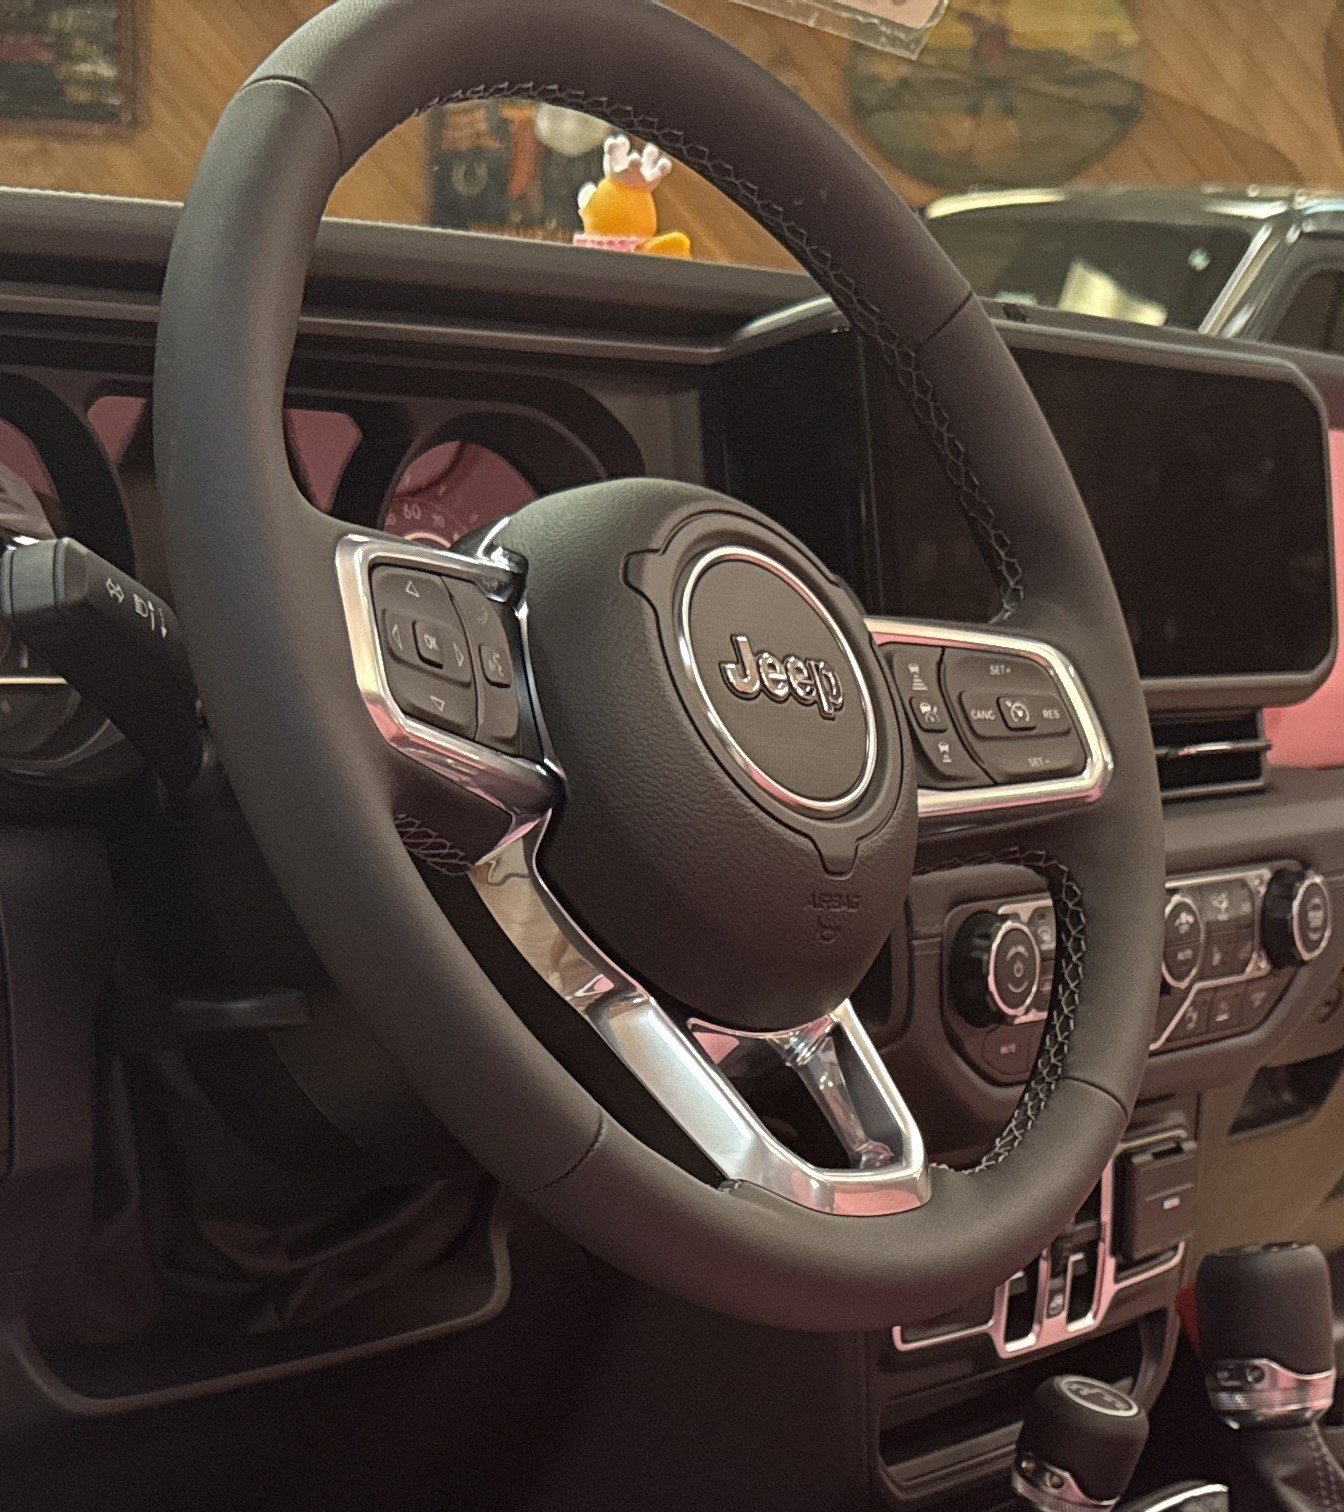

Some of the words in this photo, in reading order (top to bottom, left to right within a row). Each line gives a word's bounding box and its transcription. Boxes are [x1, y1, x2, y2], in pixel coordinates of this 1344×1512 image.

[424, 633, 439, 653] OK
[718, 633, 844, 721] Jeep
[970, 708, 996, 721] CANC
[1042, 708, 1061, 720] RES
